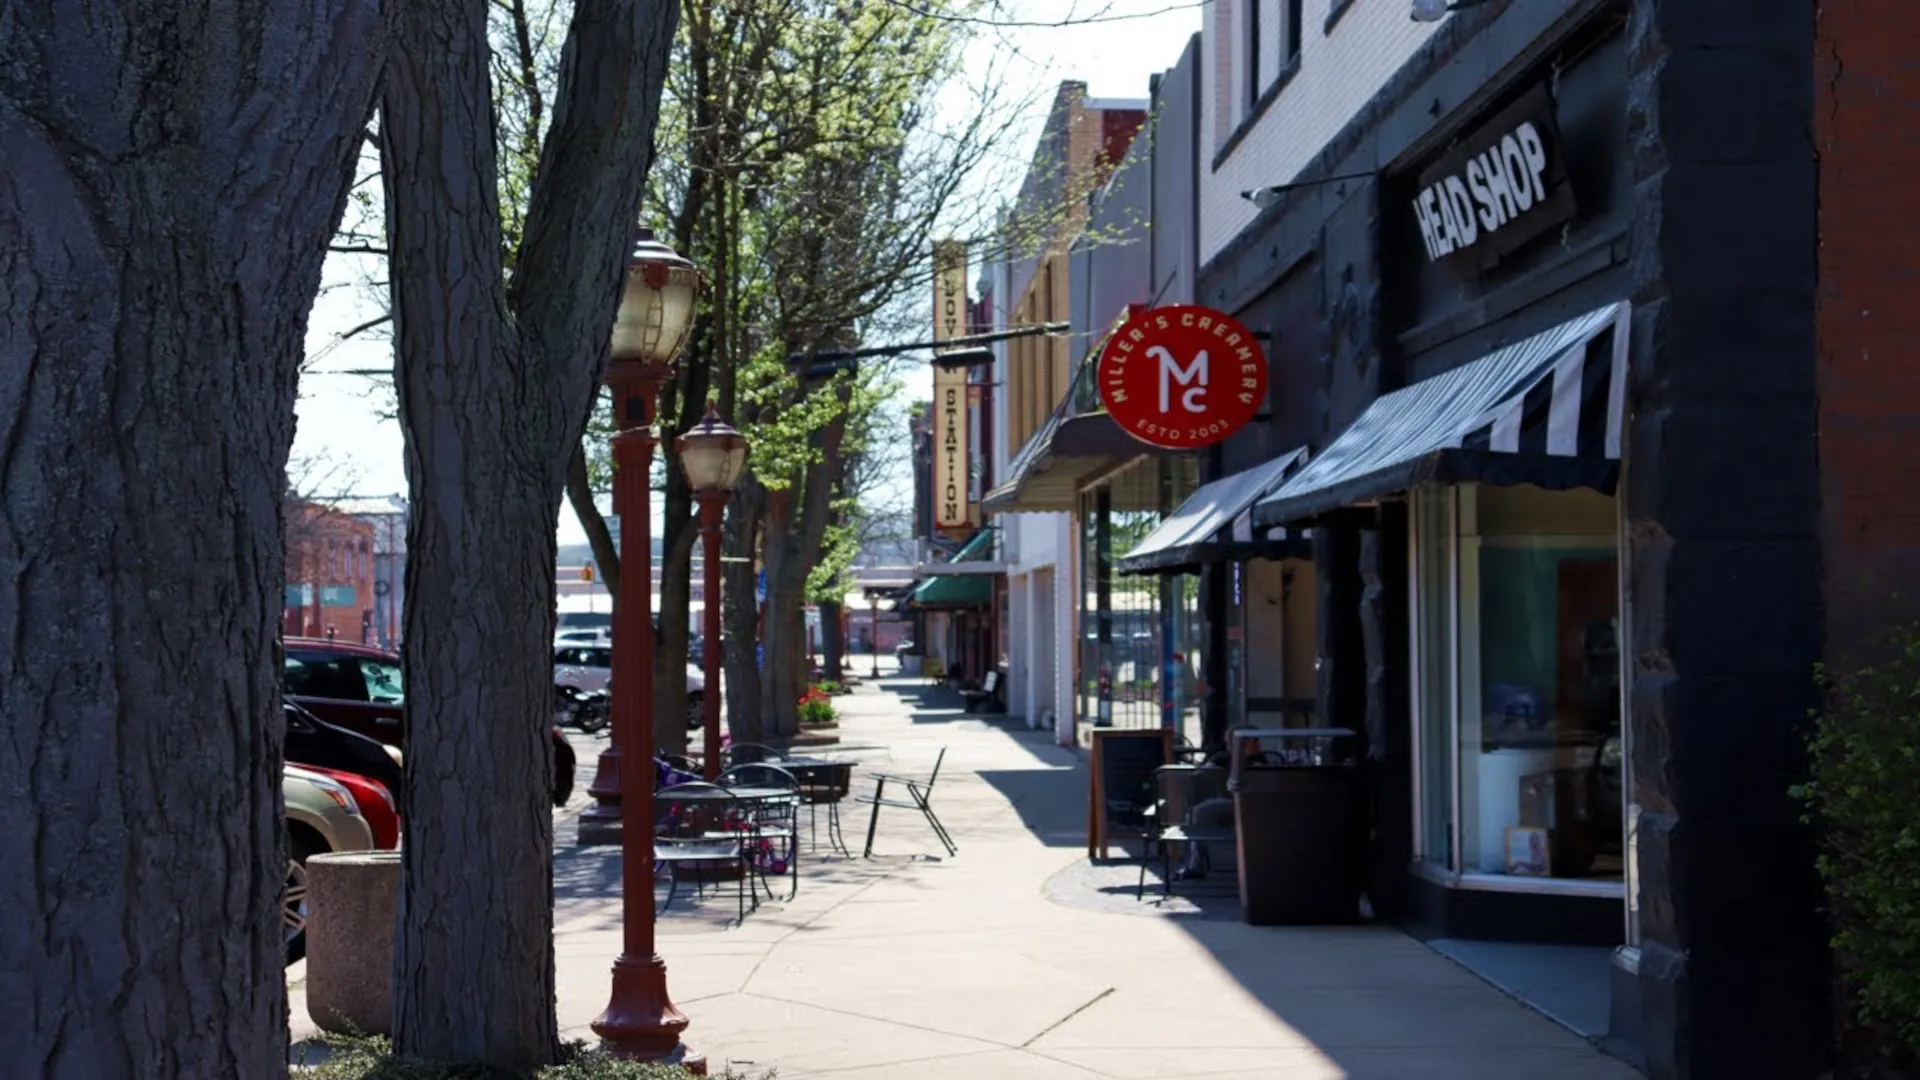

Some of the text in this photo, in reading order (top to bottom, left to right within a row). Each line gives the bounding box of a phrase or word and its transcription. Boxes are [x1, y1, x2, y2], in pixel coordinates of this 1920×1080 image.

[1412, 121, 1546, 263] HEAD SHOP
[1108, 312, 1258, 404] MILLER'S CREAMERY
[945, 388, 957, 521] STATION
